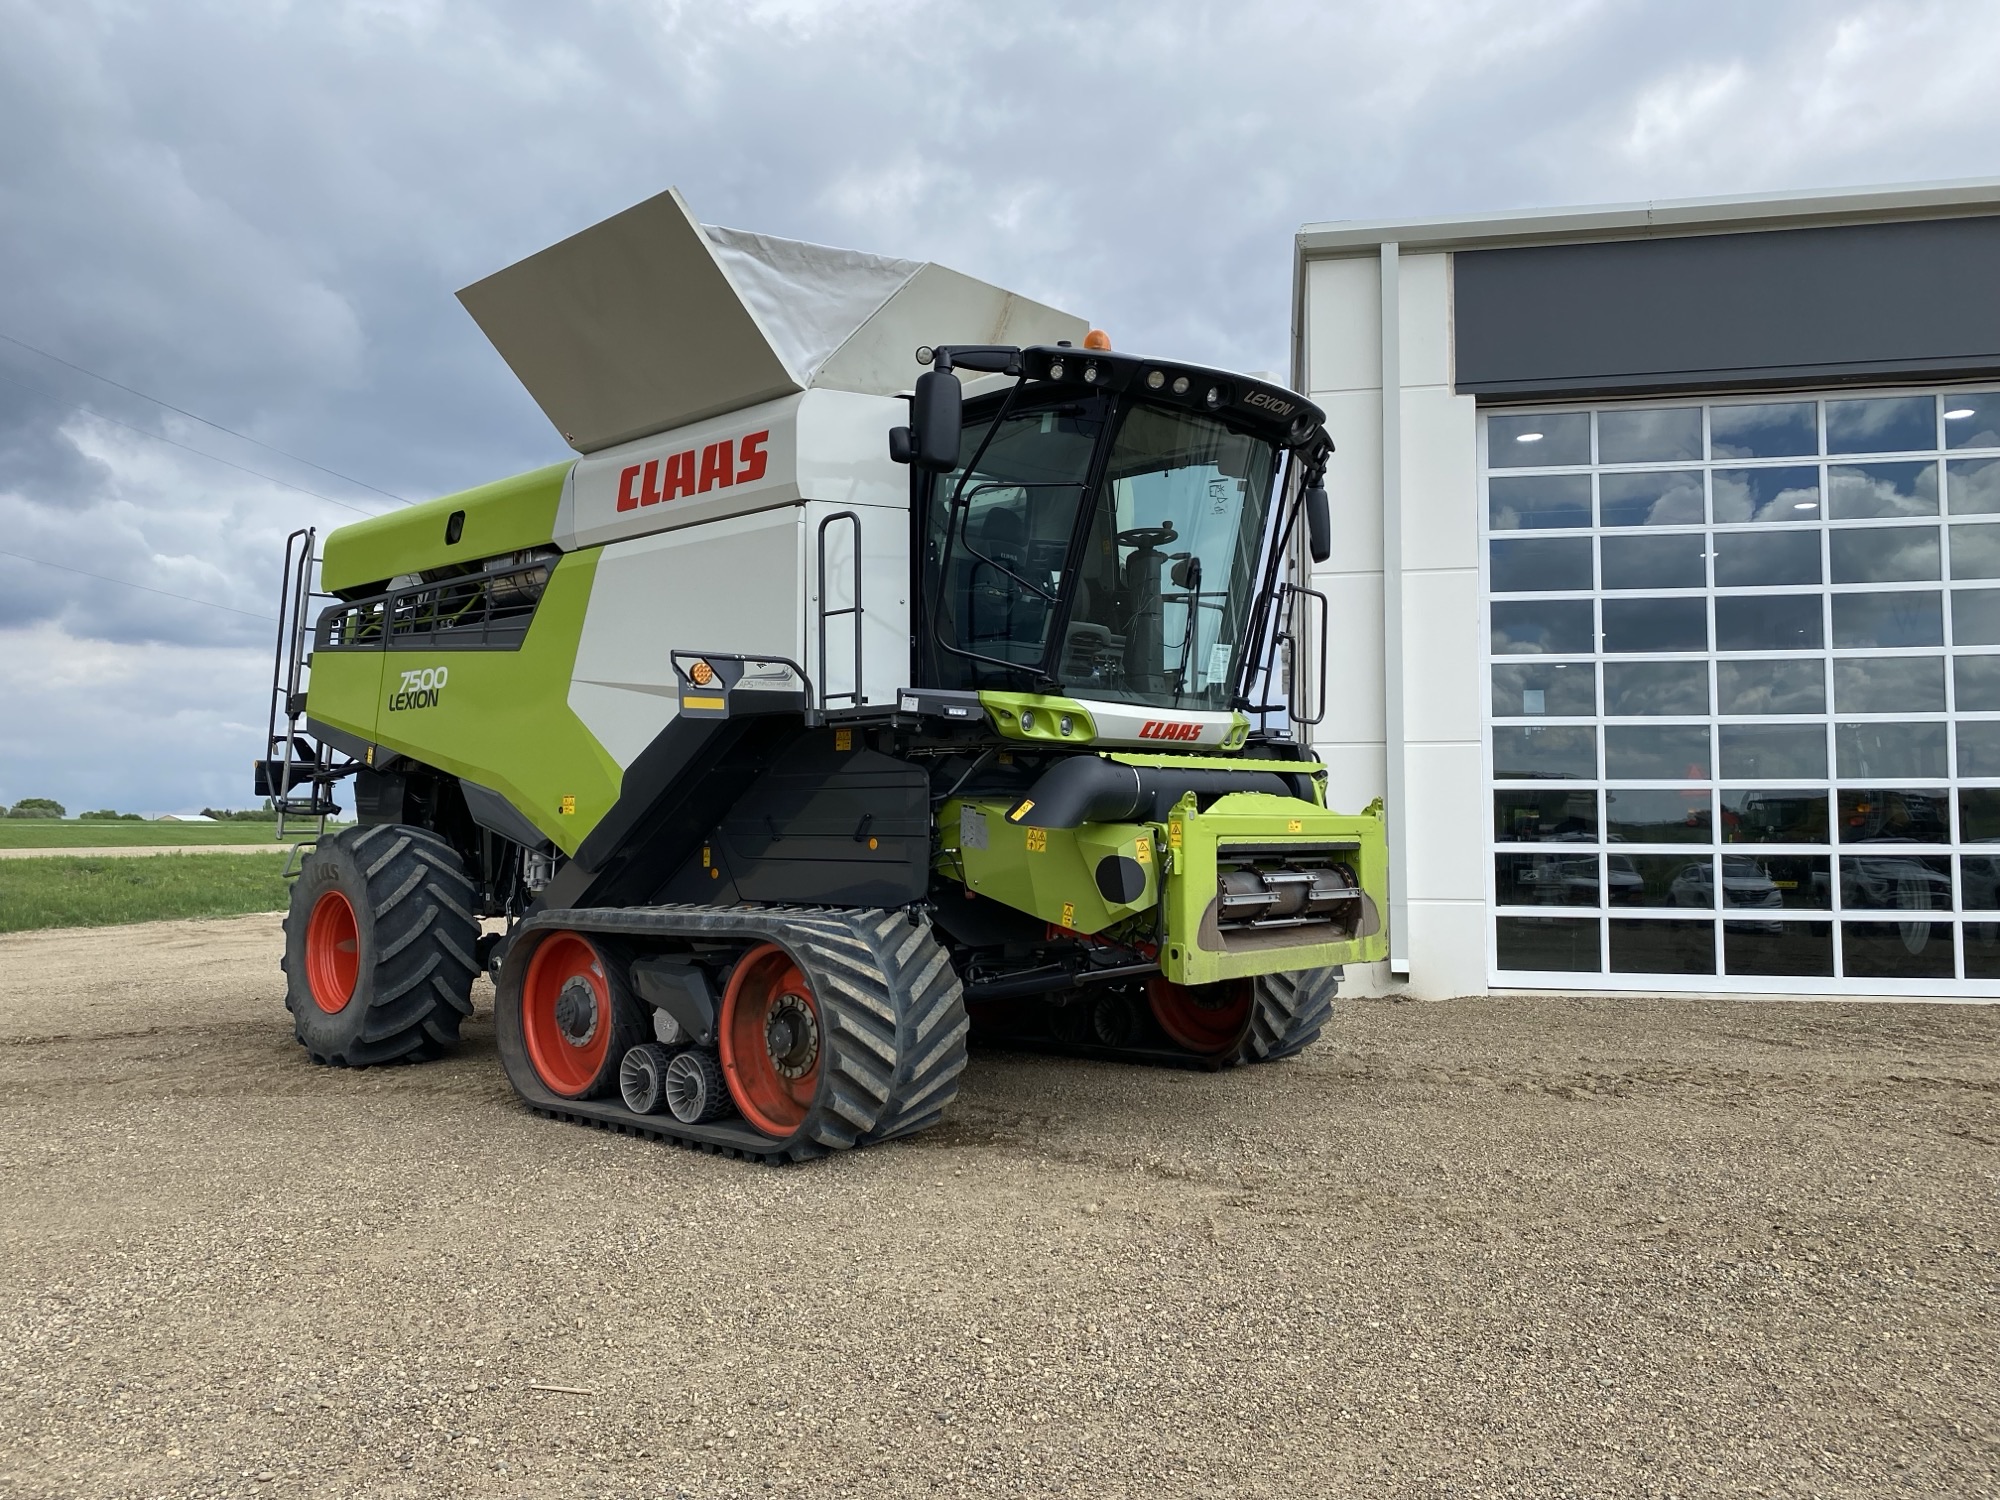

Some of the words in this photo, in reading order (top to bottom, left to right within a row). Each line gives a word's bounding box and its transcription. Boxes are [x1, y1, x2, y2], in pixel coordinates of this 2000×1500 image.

[1243, 390, 1295, 416] LEXION
[616, 429, 770, 513] CLAAS
[399, 666, 448, 693] 7500
[388, 688, 439, 712] LEXION
[1138, 721, 1204, 741] CLAAS
